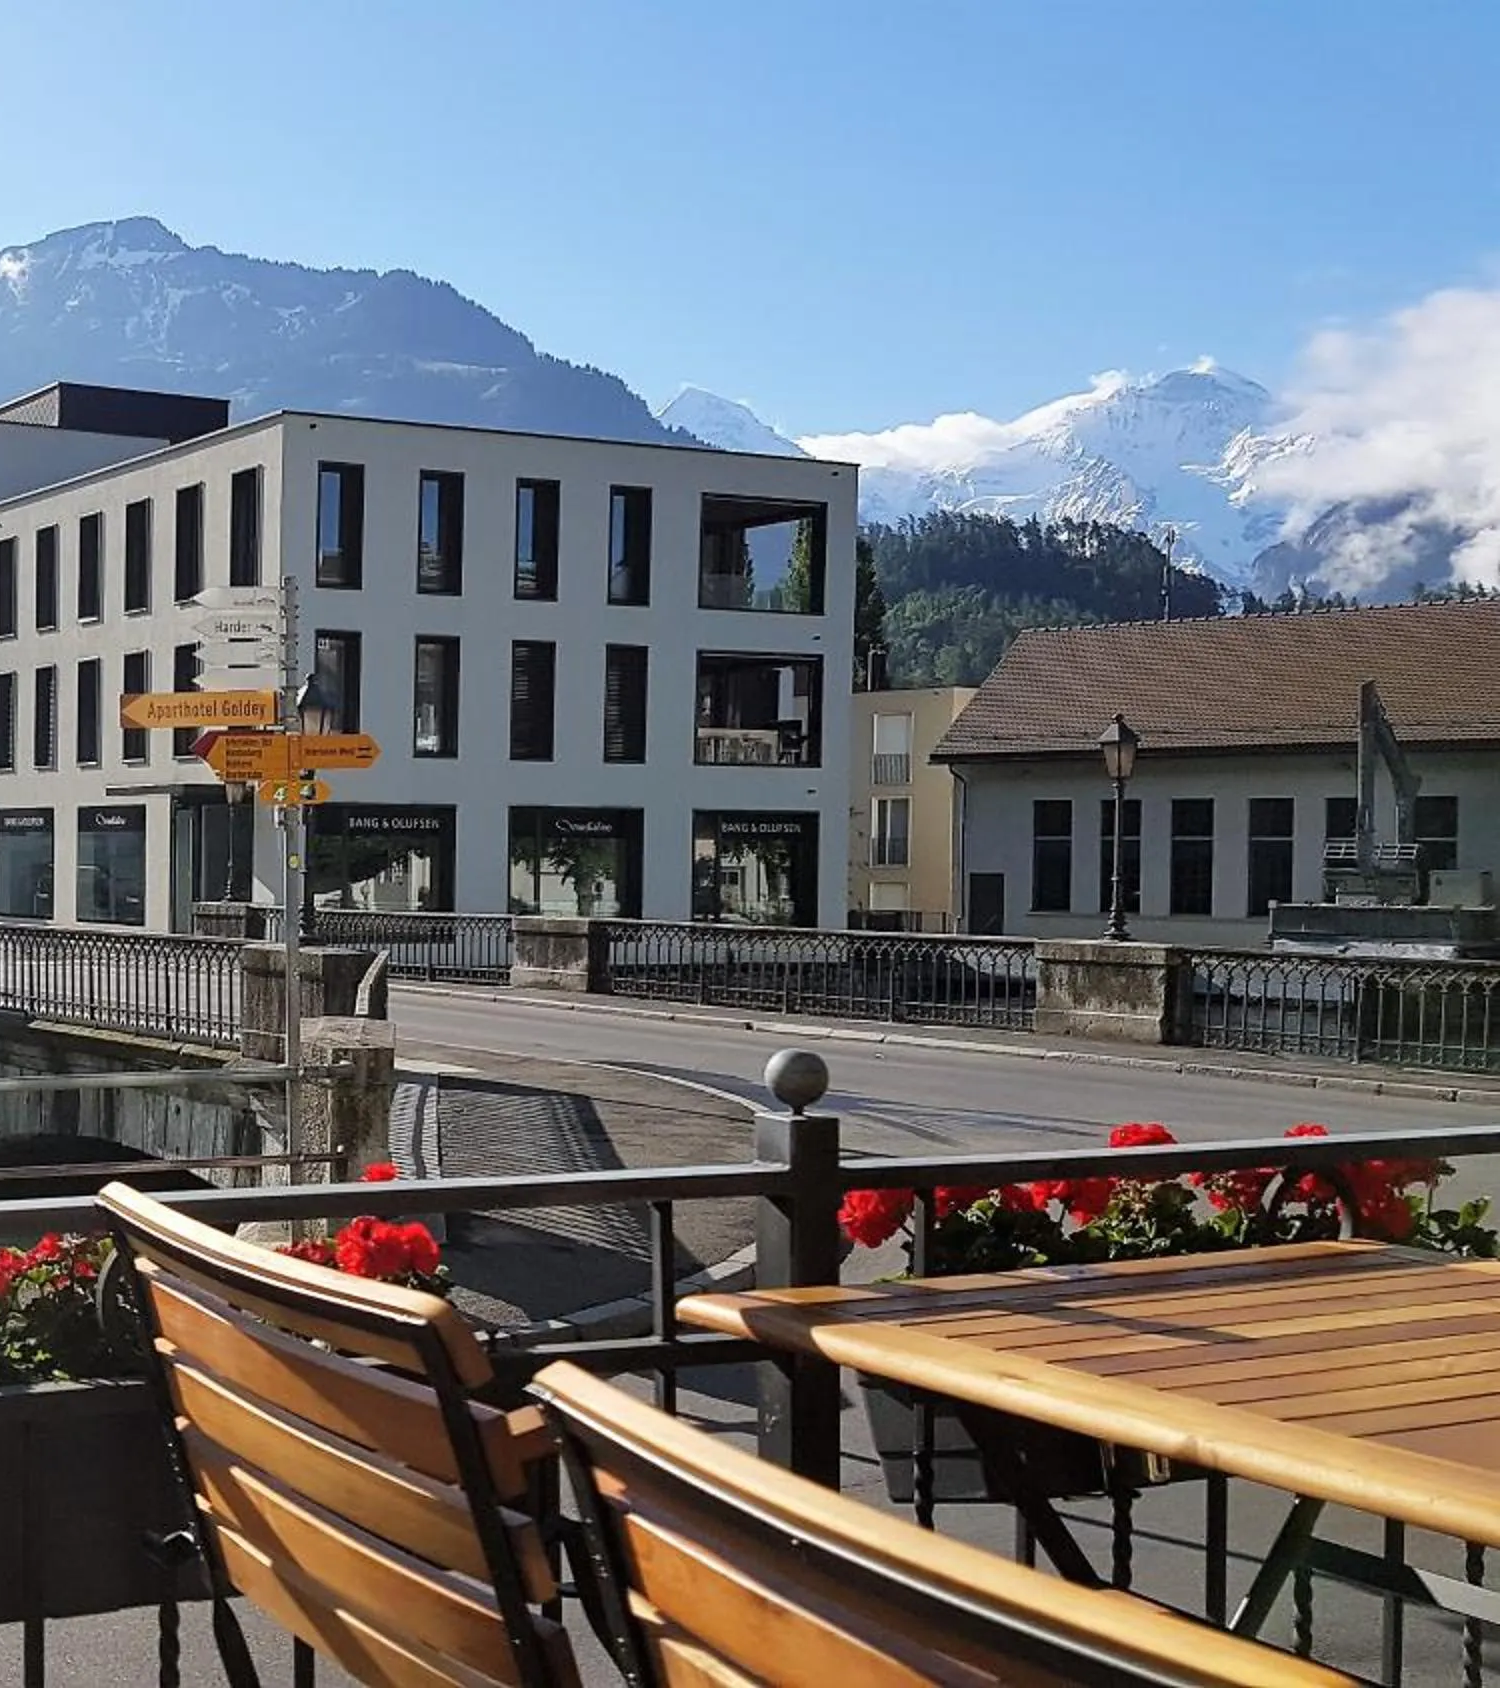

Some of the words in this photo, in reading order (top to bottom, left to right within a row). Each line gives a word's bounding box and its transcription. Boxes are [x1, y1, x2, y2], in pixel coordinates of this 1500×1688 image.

[147, 700, 217, 720] Aparthotel
[221, 700, 266, 720] Goldey
[349, 816, 379, 829] BANG
[391, 816, 439, 829] OLUFSEN
[721, 822, 749, 833] BANG
